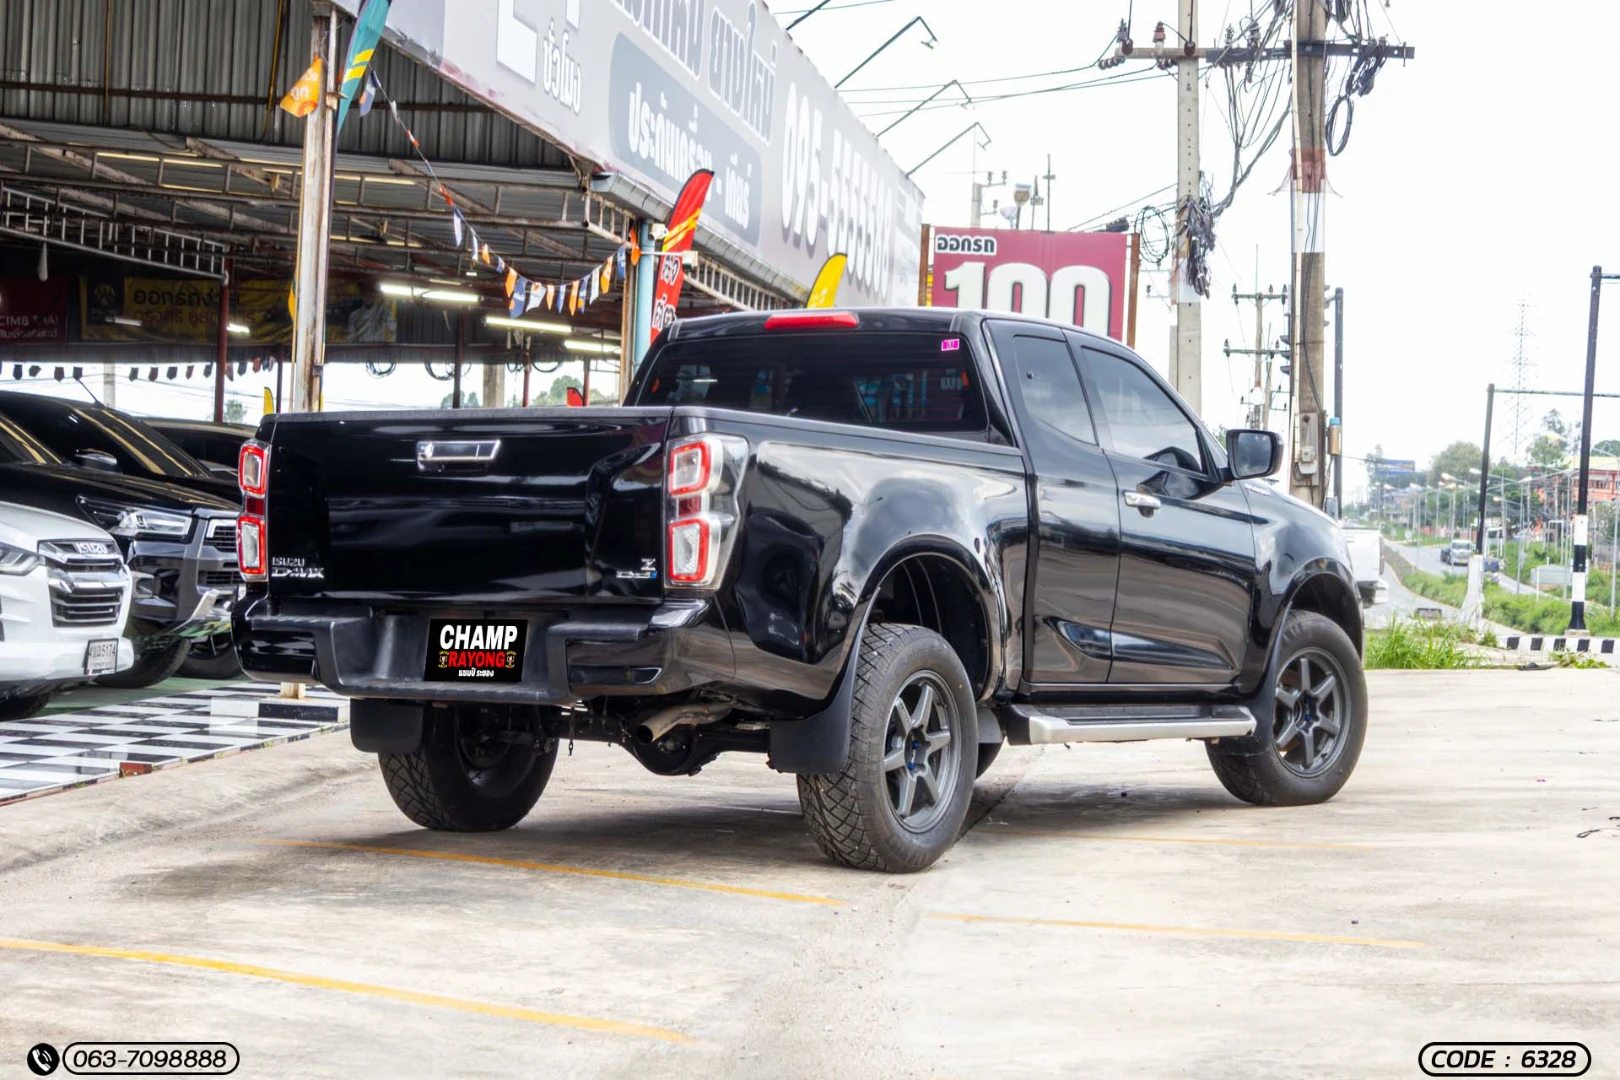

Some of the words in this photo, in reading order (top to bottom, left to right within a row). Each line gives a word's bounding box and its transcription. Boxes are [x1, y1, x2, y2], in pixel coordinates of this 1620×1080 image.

[543, 18, 581, 115] ชั่วโมง
[725, 152, 752, 229] เกียร์
[936, 235, 996, 254] ออกรถ
[75, 542, 108, 554] ISUZU
[272, 557, 305, 567] ISUZU
